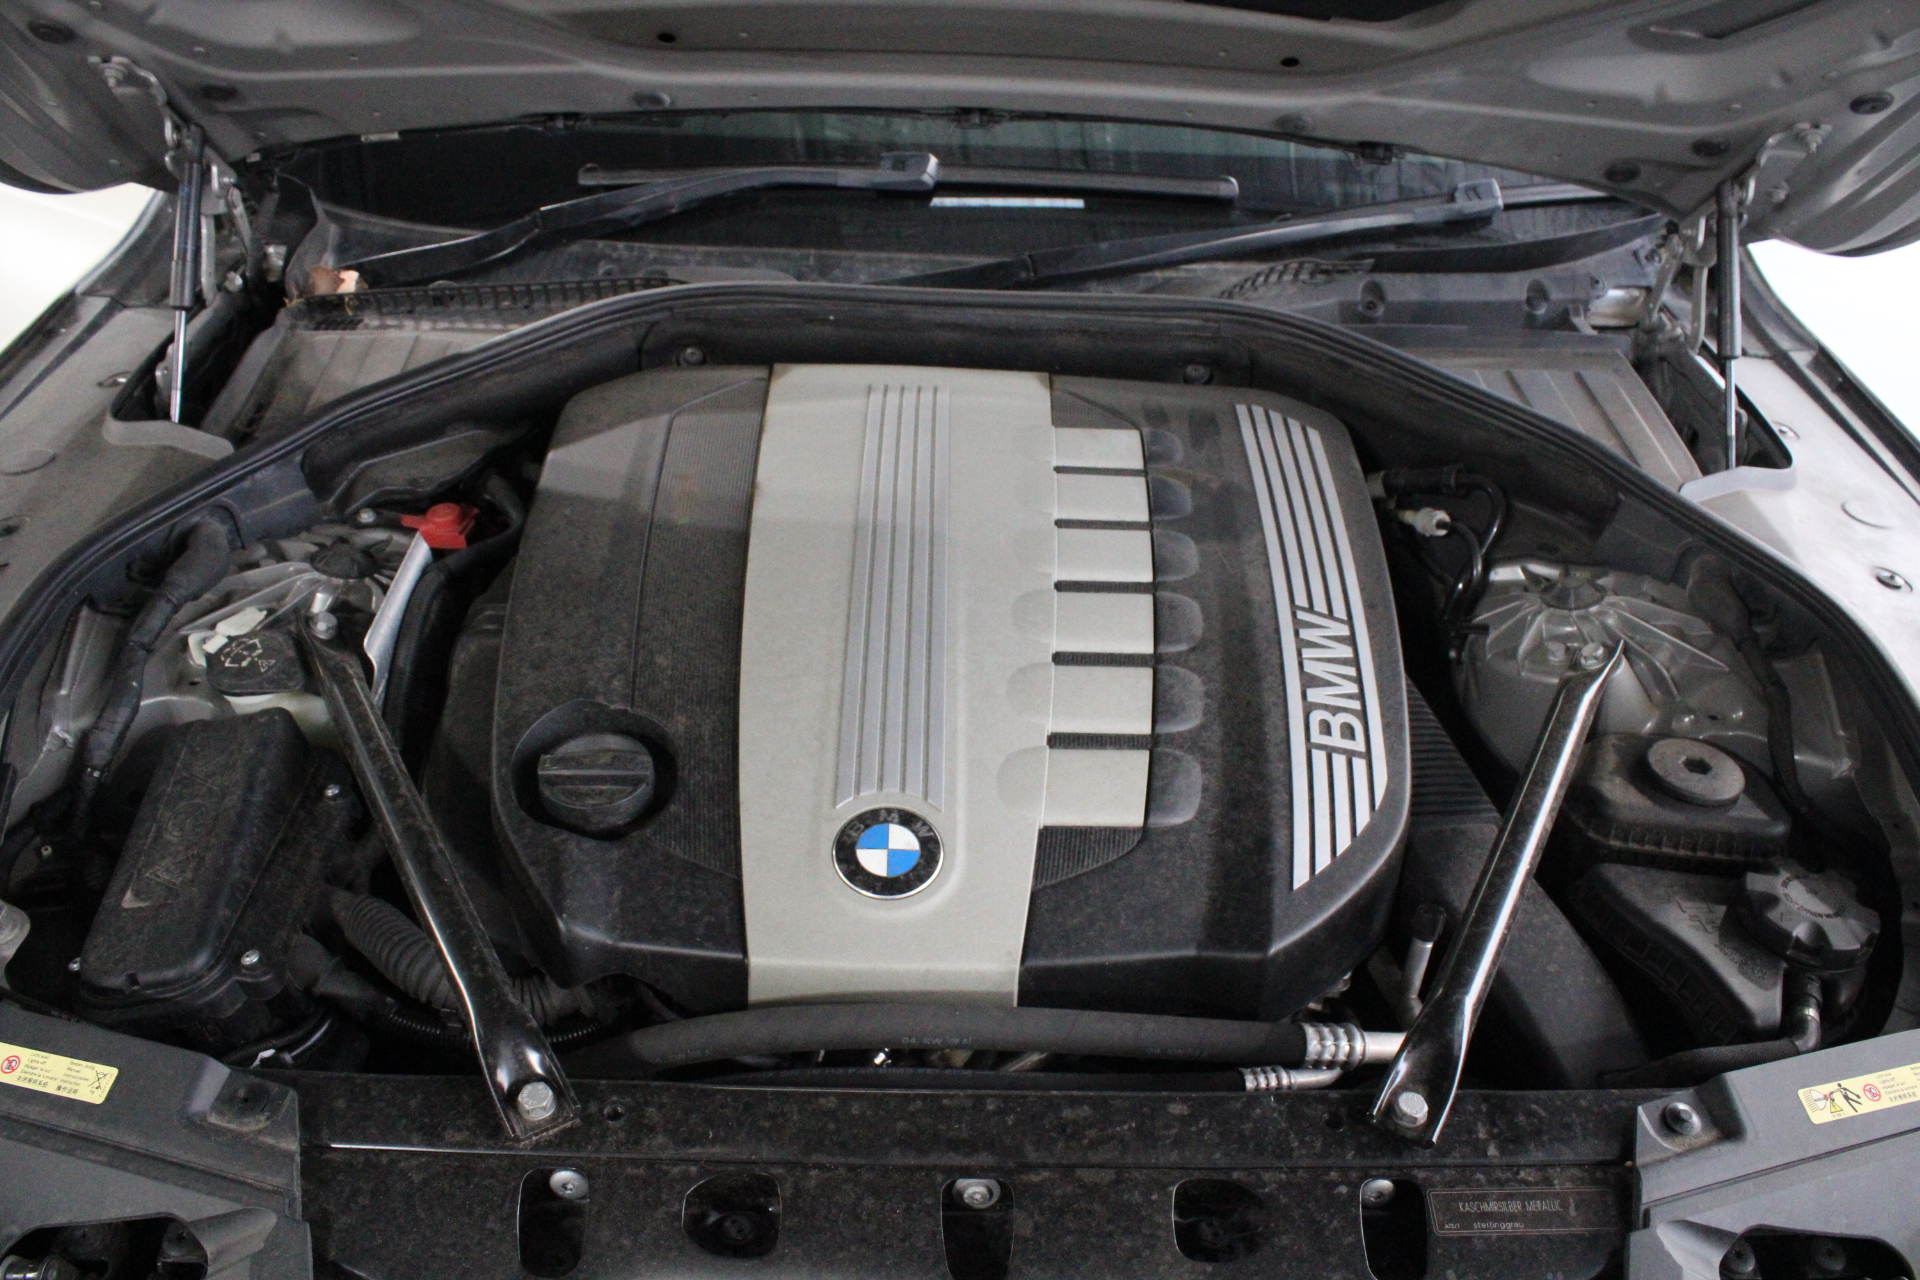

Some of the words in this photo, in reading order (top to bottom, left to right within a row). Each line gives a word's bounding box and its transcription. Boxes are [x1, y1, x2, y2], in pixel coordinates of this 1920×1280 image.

[1296, 609, 1366, 753] BMW
[845, 809, 935, 838] BMW
[1458, 1200, 1522, 1213] KASCHMIRSILBER
[1525, 1199, 1563, 1212] METALLIC
[1473, 1221, 1525, 1229] sterlinggrau
